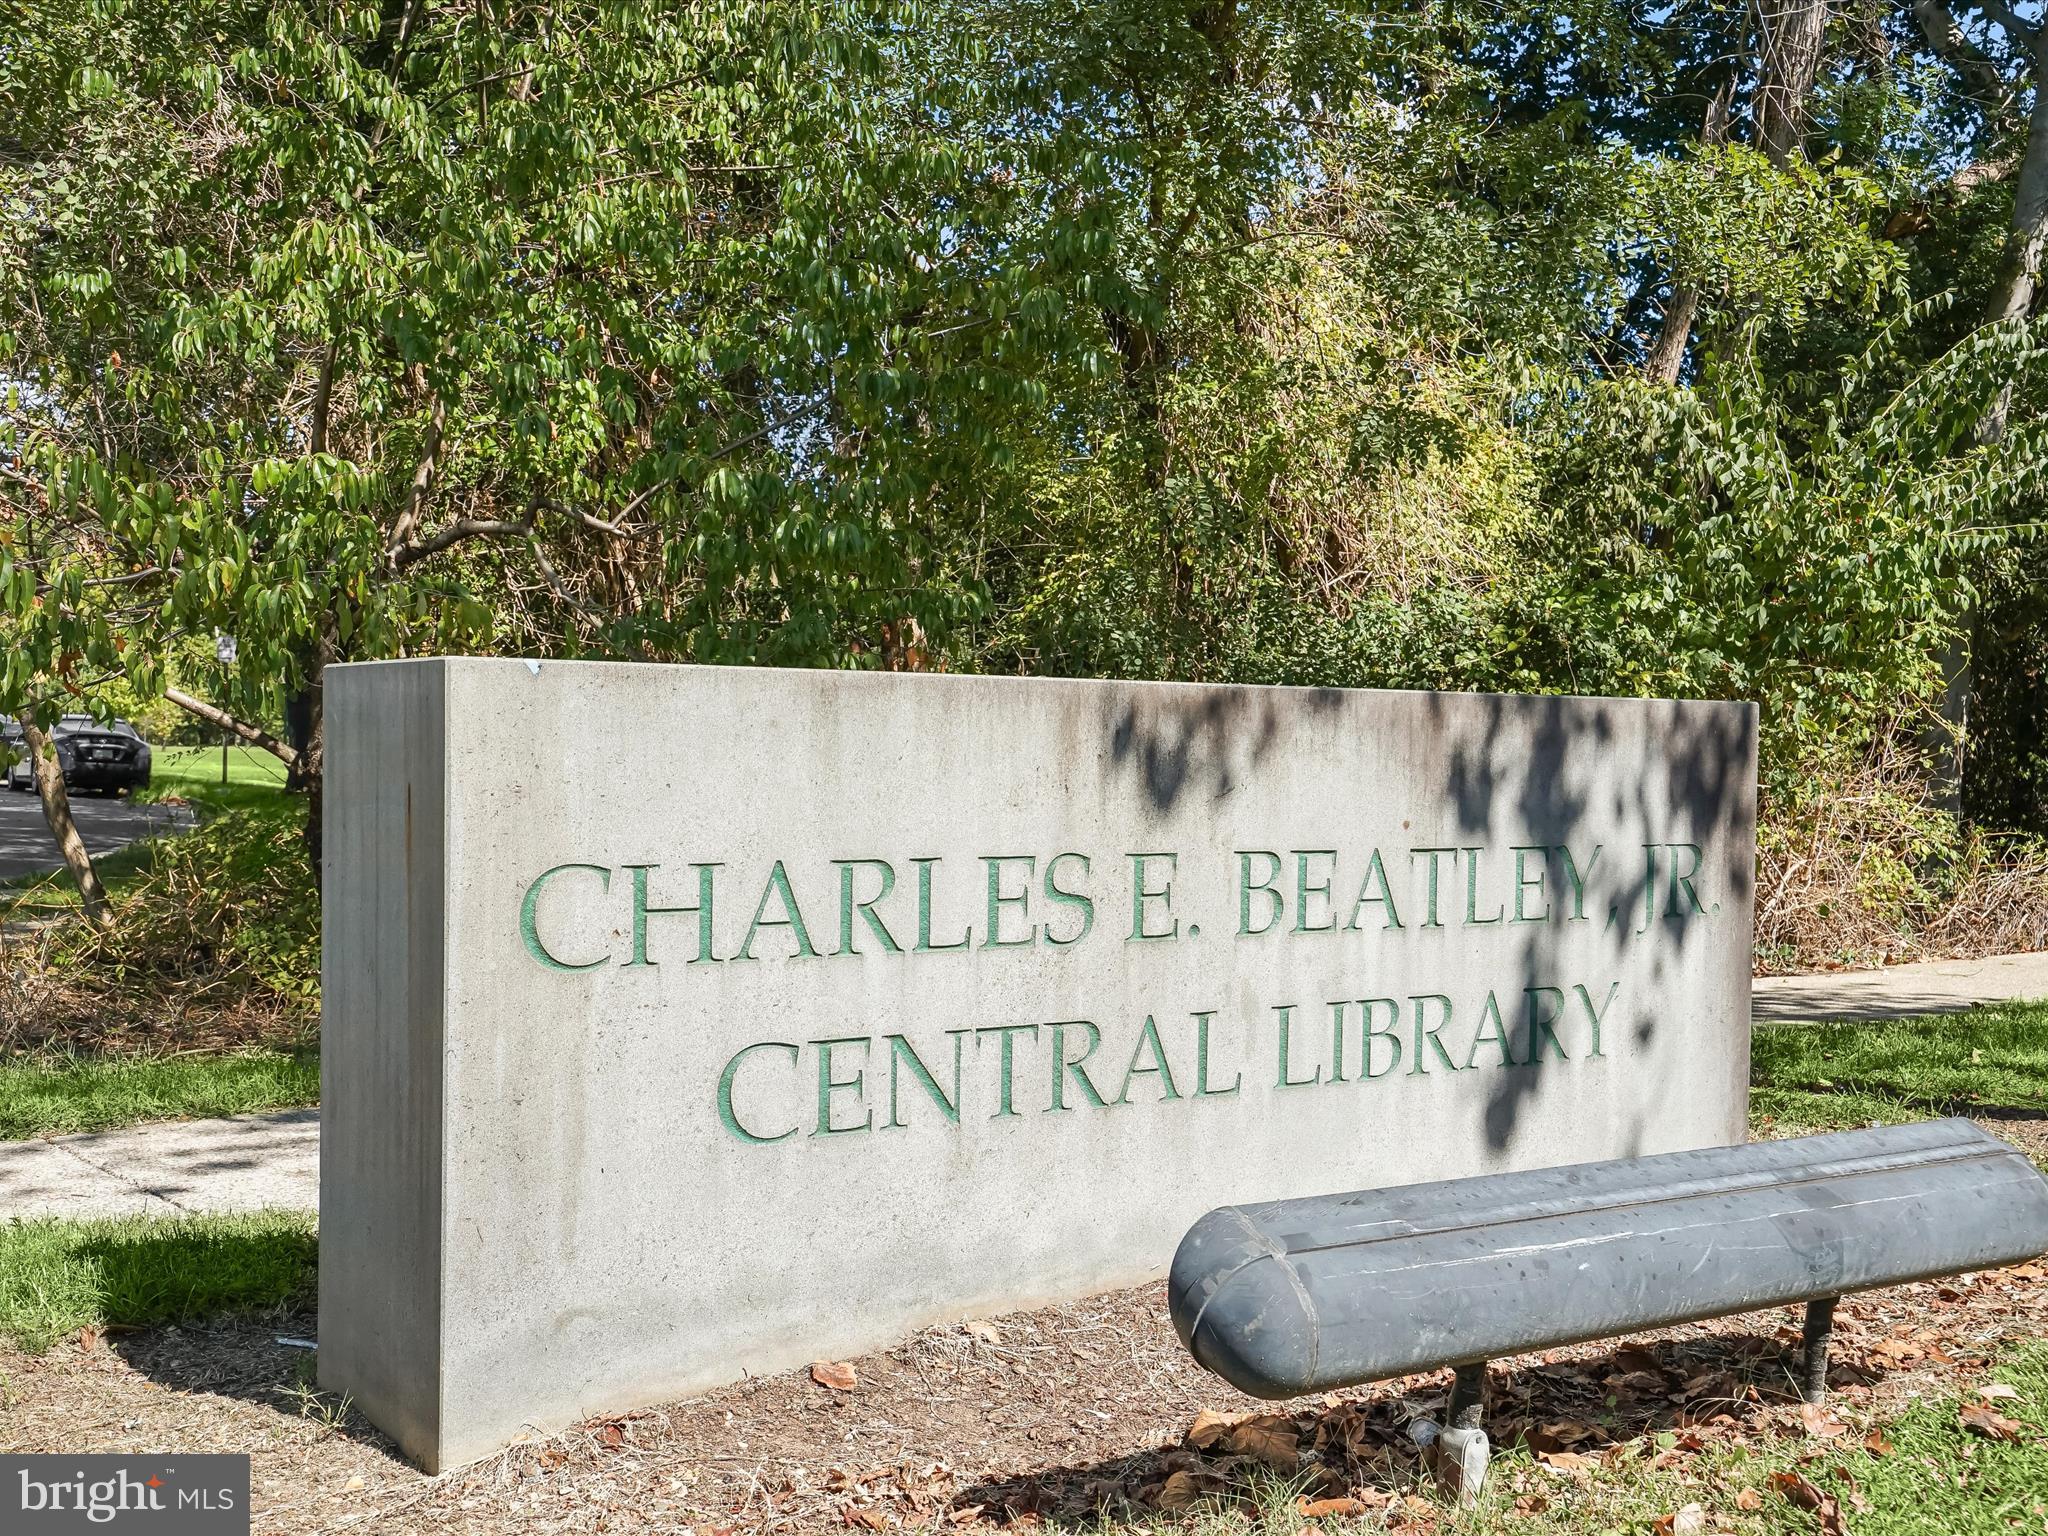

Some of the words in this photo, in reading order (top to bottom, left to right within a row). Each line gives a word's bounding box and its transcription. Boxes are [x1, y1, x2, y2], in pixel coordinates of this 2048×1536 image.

[519, 852, 1095, 973] CHARLES
[1125, 852, 1200, 942] E.
[1233, 844, 1619, 937] BEATLEY,
[1636, 842, 1722, 936] JR.
[716, 1010, 1241, 1146] CENTRAL
[1271, 981, 1620, 1090] LIBRARY
